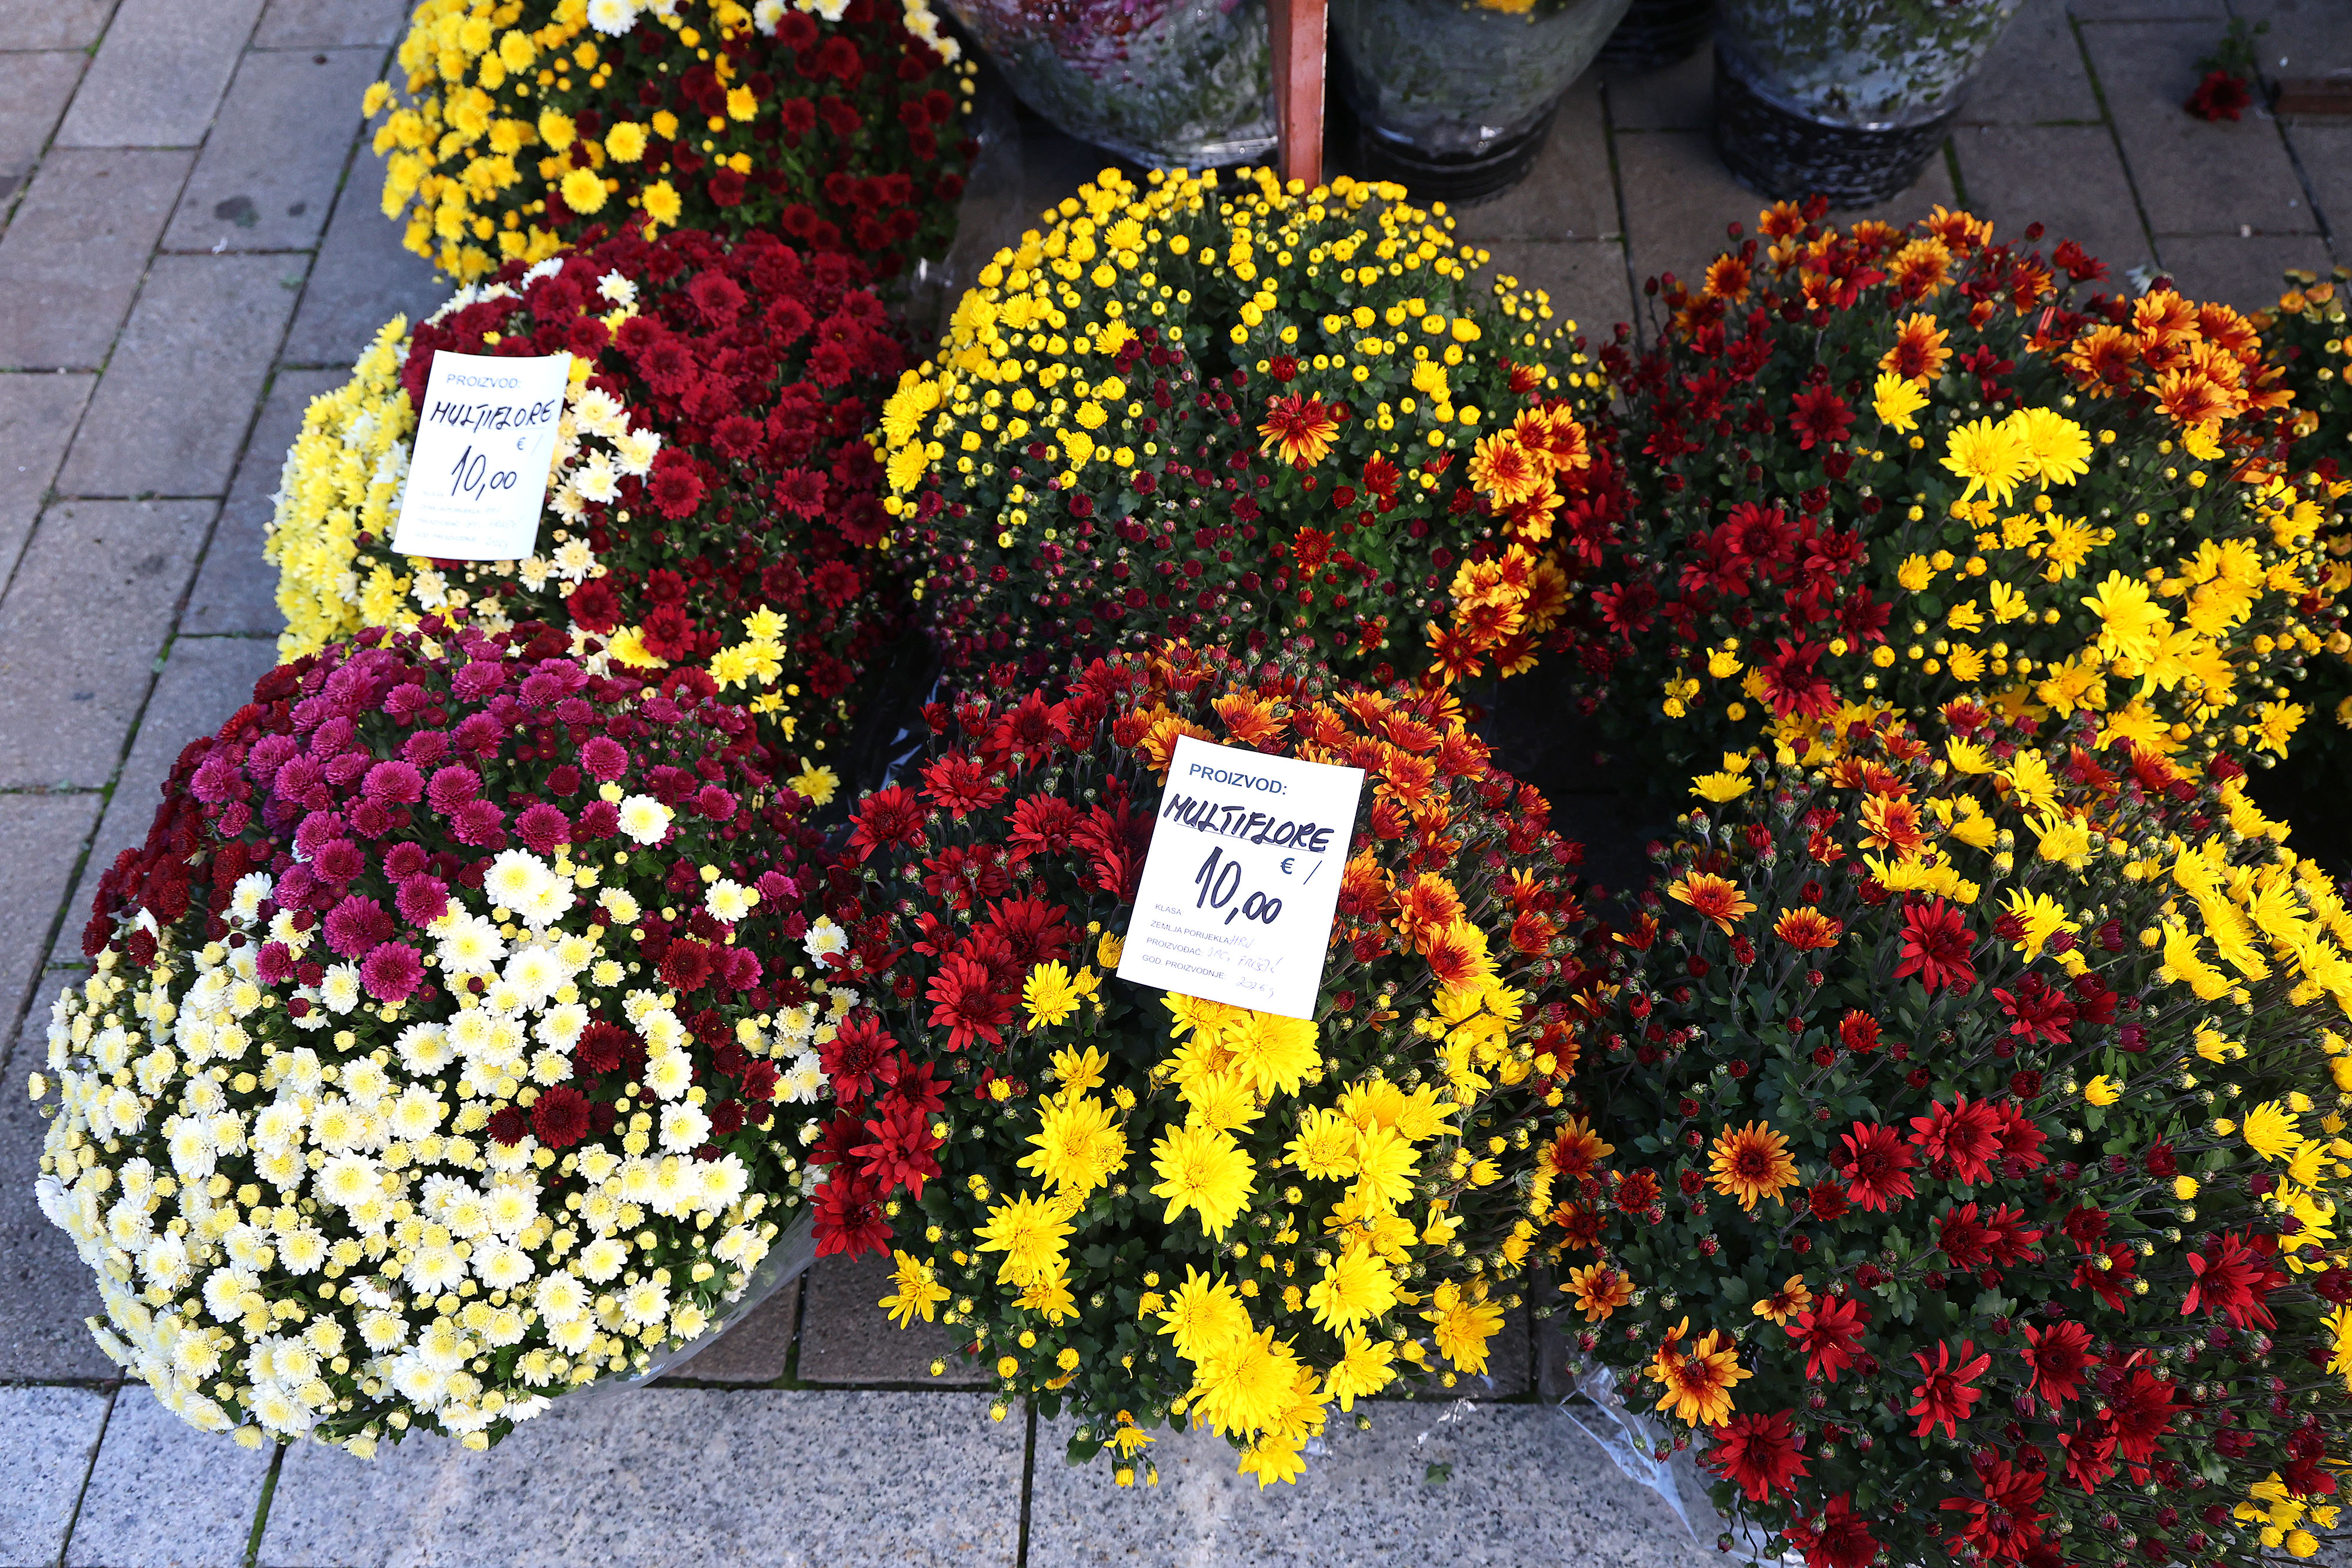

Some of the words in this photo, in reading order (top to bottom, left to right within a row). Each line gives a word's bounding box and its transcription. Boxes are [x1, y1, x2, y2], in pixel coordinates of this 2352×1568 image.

[430, 399, 556, 433] MULTIFLORE
[517, 437, 526, 451] €
[451, 445, 517, 501] 10,00
[1189, 763, 1287, 795] PROIZVOD:
[1163, 794, 1334, 852] MULTIFLORE
[1280, 858, 1295, 874] €
[1195, 847, 1282, 925] 10,00
[1155, 904, 1184, 916] KLASA:
[1150, 920, 1182, 934] ZEMLJA
[1142, 955, 1162, 965] GOD.
[1165, 960, 1226, 979] PROIZVODNJE:
